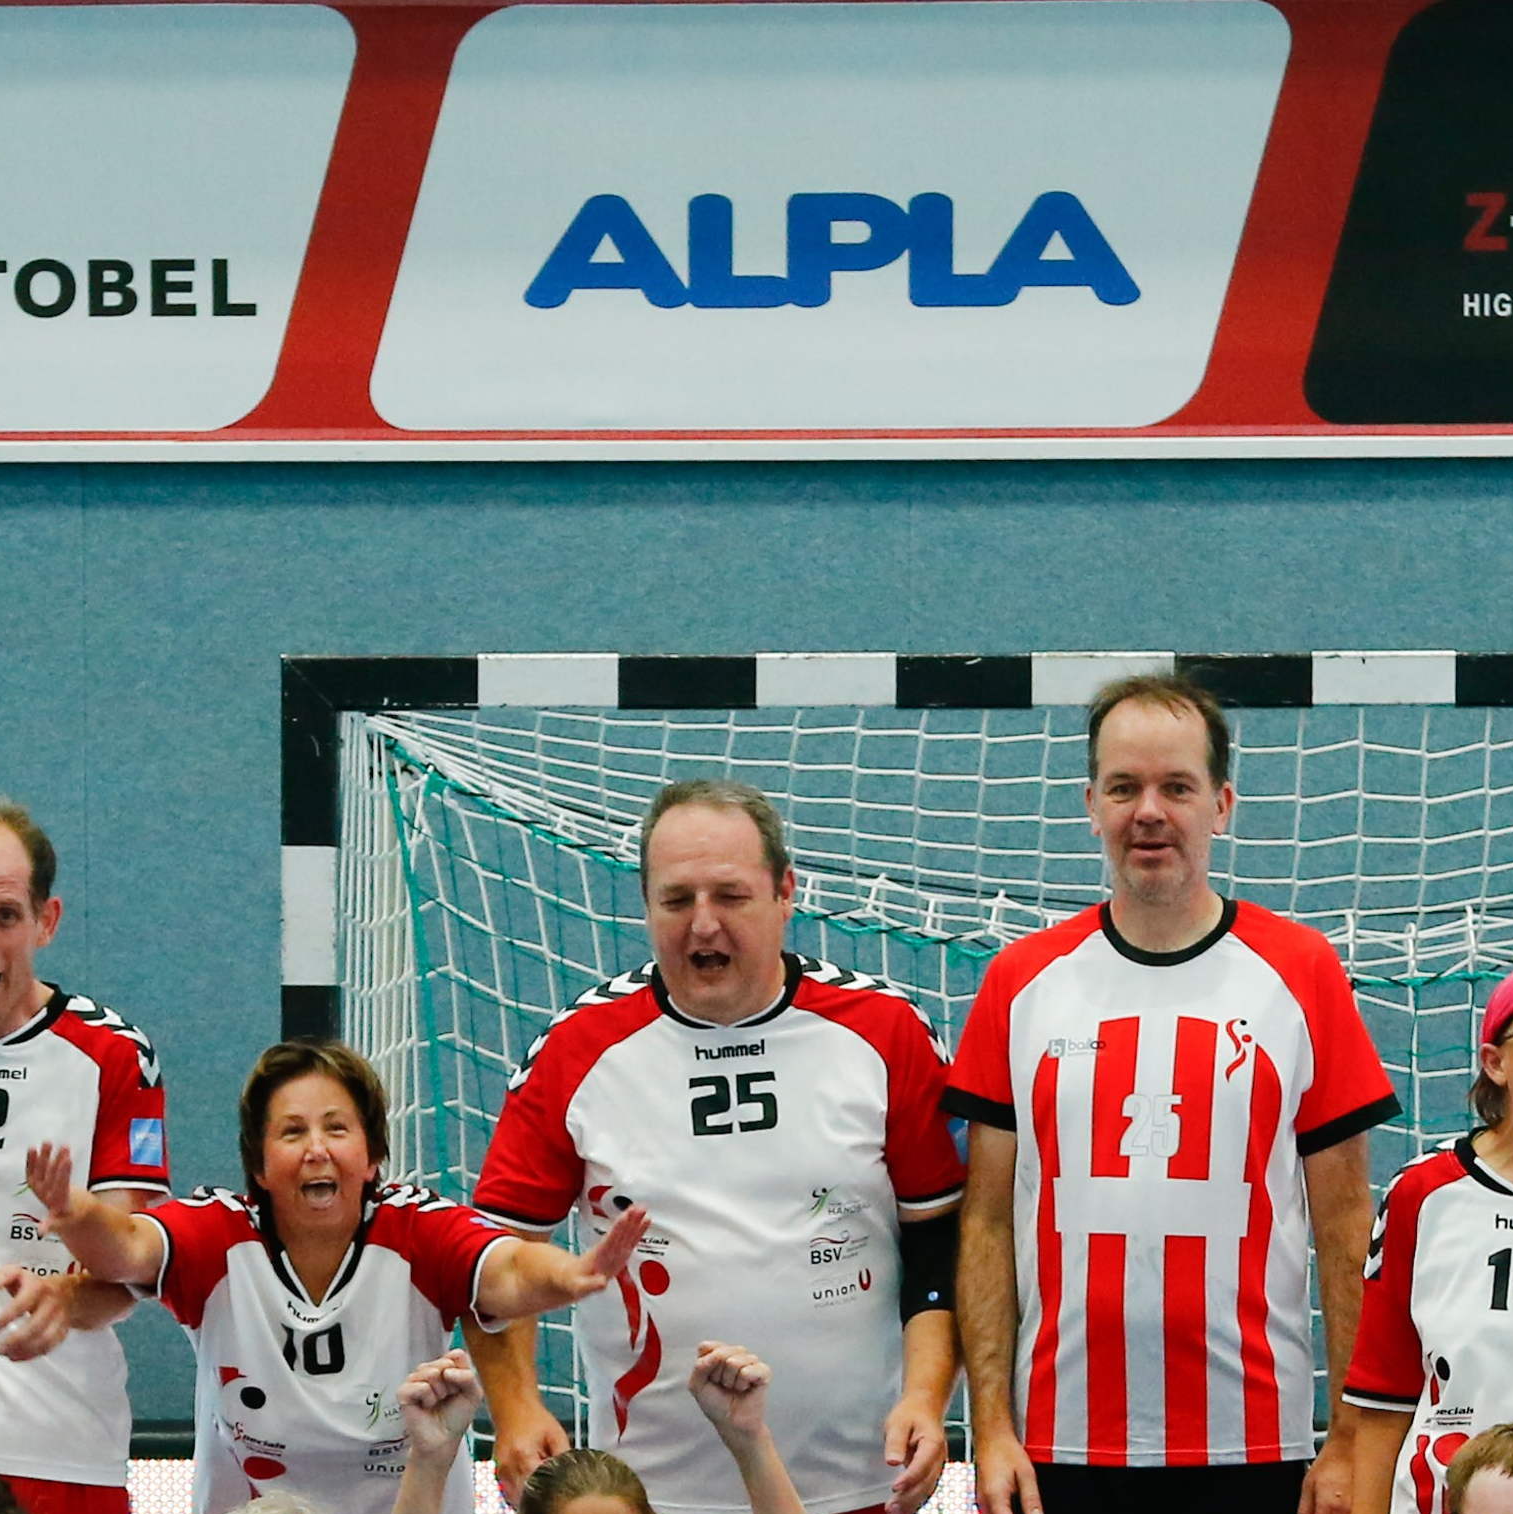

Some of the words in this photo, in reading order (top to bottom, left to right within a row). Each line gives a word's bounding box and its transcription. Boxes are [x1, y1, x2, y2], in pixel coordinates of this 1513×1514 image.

[523, 191, 1141, 309] ALPLA
[693, 1038, 767, 1062] hummel
[688, 1070, 778, 1137] 25
[1118, 1092, 1184, 1159] 25
[810, 1246, 843, 1265] BSV
[812, 1282, 857, 1301] union
